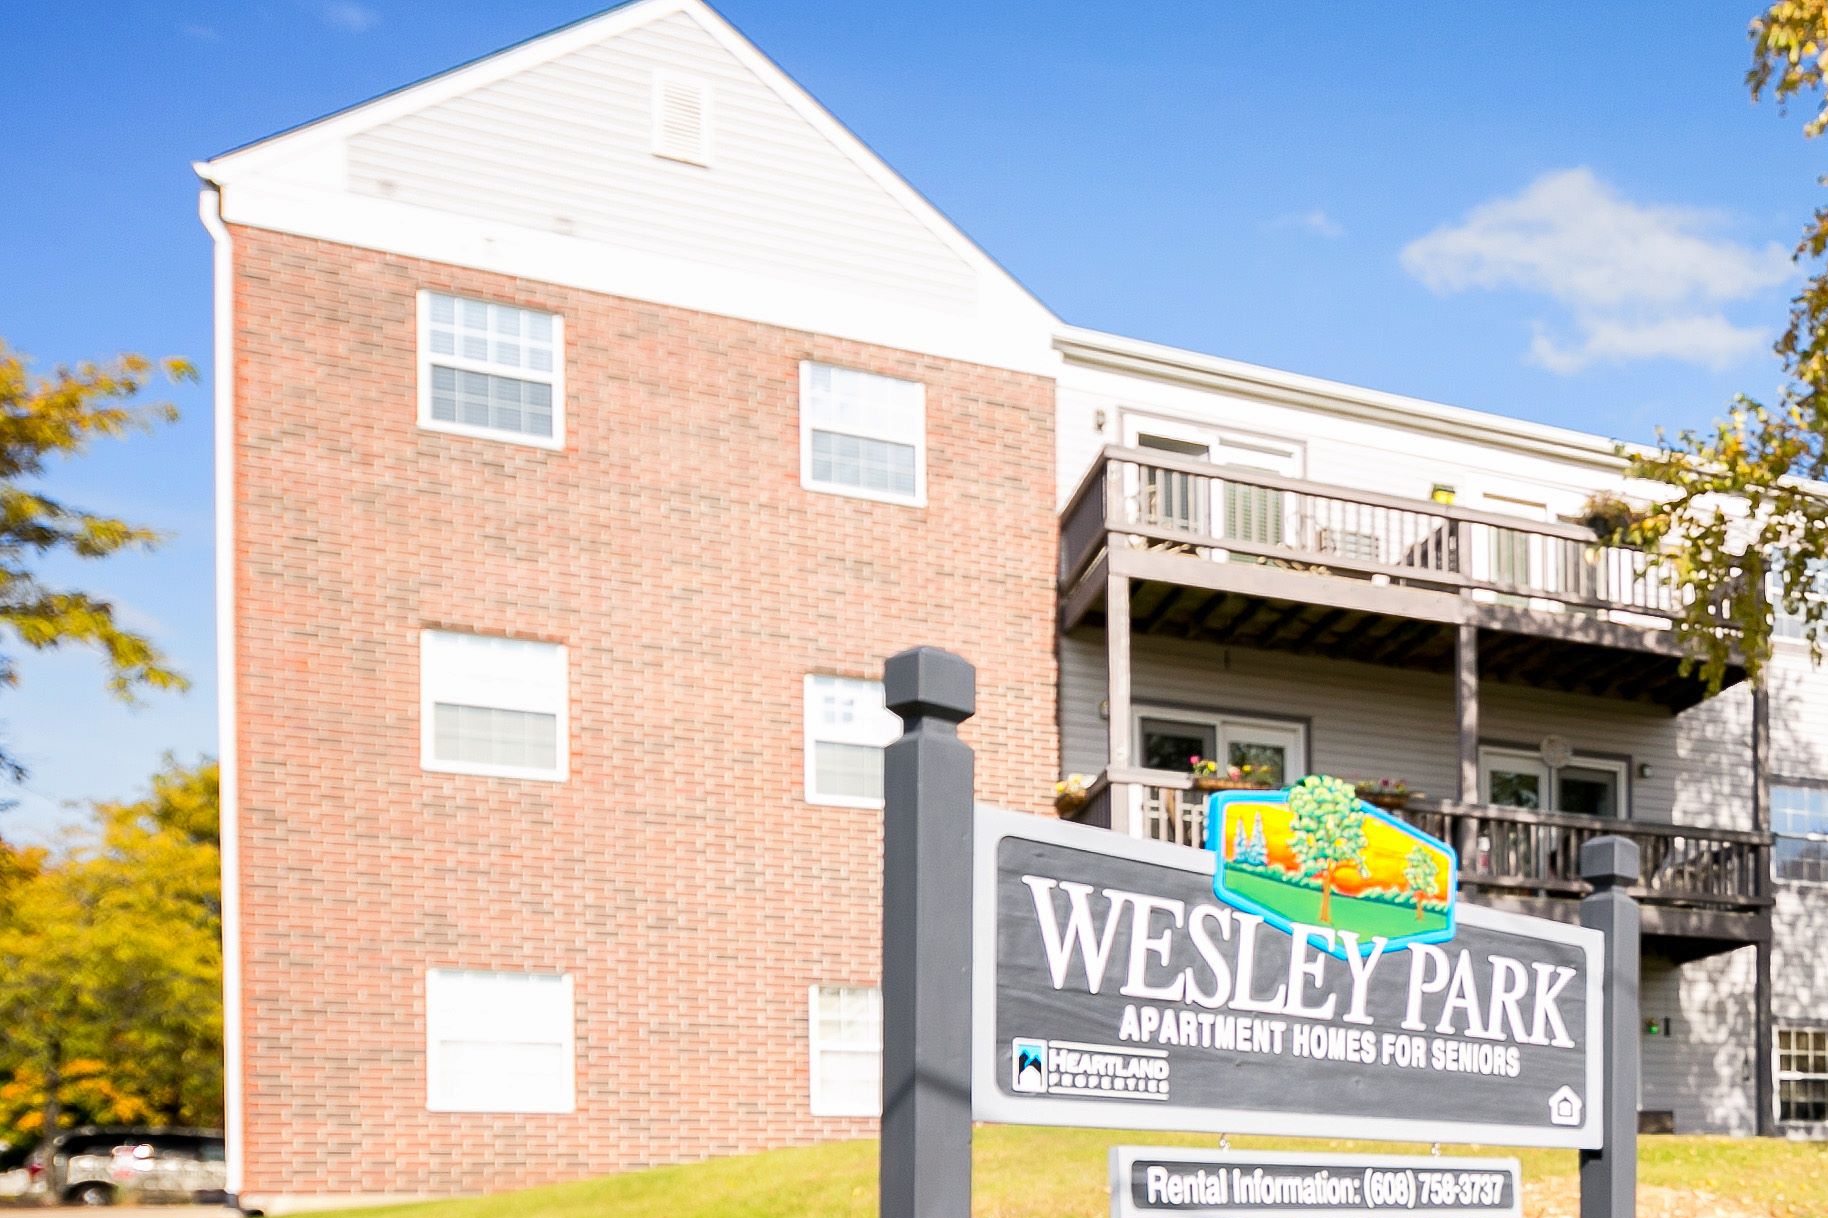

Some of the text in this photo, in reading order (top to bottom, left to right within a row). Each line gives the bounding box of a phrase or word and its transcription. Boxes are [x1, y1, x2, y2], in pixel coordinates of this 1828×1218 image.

[1021, 874, 1577, 1049] WESLEY PARK
[1049, 1048, 1170, 1080] HEARTLAND
[1118, 1004, 1521, 1078] APARTMENT HOMES FOR SENIORS
[1147, 1165, 1505, 1209] Rental Information: (608) 758-3737
